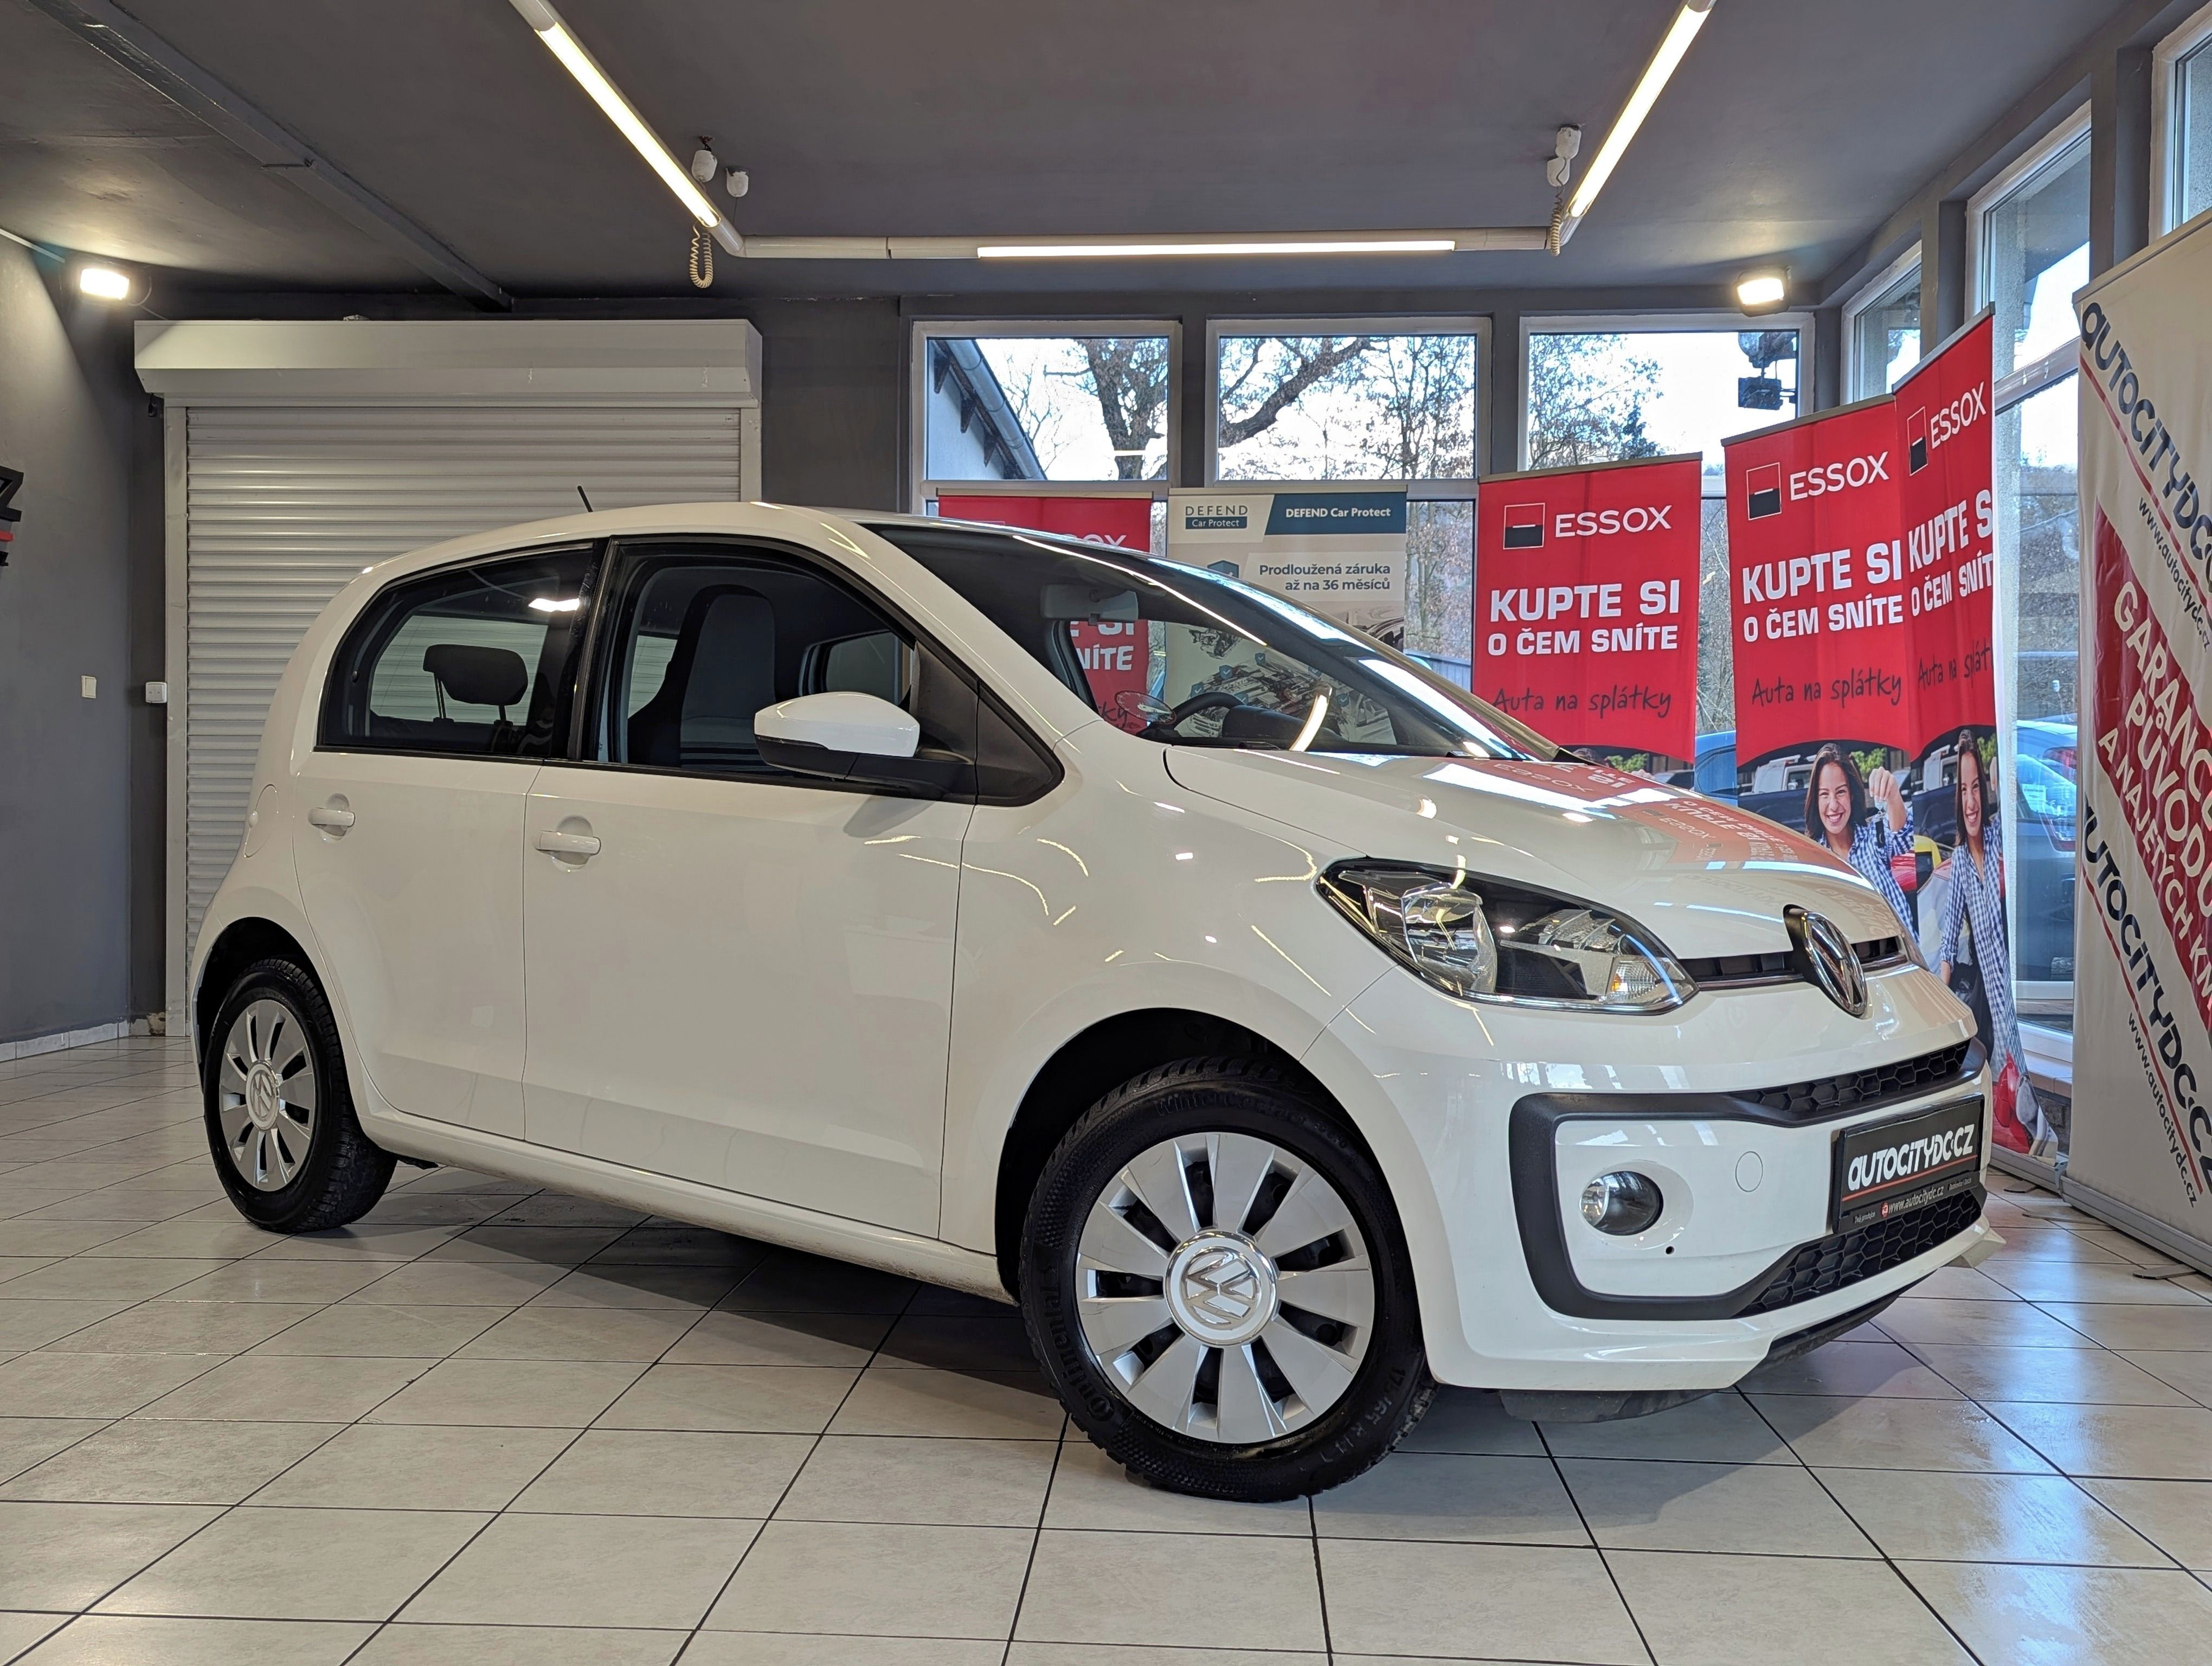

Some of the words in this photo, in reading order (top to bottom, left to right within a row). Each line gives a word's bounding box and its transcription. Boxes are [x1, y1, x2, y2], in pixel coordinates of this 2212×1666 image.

[1930, 381, 1986, 449] ESSOX
[1790, 451, 1889, 501] ESSOX
[1186, 505, 1248, 516] DEFEND
[1192, 519, 1206, 527] Car
[1208, 518, 1240, 527] Protect
[1285, 508, 1328, 518] DEFEND
[1330, 508, 1348, 517] Car
[1351, 508, 1391, 517] Protect
[1555, 505, 1672, 537] ESSOX
[1908, 499, 1969, 573] KUPTE
[1976, 489, 1993, 538] S
[1259, 563, 1342, 575] Prodloužená
[1345, 563, 1391, 575] záruka
[1285, 579, 1301, 591] až
[1303, 582, 1320, 591] na
[1322, 579, 1339, 591] 36
[1342, 577, 1391, 591] měsíců
[1742, 549, 1853, 605] KUPTE
[1866, 540, 1902, 584] SI
[1911, 586, 1920, 617] O
[1924, 571, 1953, 611] ČEM
[1959, 549, 1993, 597] SNÍT
[2139, 497, 2210, 653] www.autocitydc.cz
[1490, 584, 1623, 623] KUPTE
[1639, 579, 1681, 615] SI
[1744, 616, 1759, 642] O
[1766, 603, 1819, 639] ČEM
[1828, 593, 1903, 632] SNÍTE
[1075, 644, 1134, 670] NÍTE
[1488, 633, 1506, 656] O
[1517, 627, 1580, 655] ČEM
[1591, 622, 1678, 652] SNÍTE
[1918, 653, 1944, 691] Auta
[1964, 637, 1991, 688] splát
[1493, 687, 1544, 713] Auta
[1555, 694, 1577, 710] na
[1588, 684, 1671, 720] splátky
[1752, 676, 1794, 706] Auta
[1804, 682, 1821, 700] na
[1831, 668, 1901, 708] splátky
[2098, 727, 2118, 764] A
[2116, 754, 2194, 940] NAJETÝCH
[2129, 1012, 2197, 1208] www.autocitydc.cz
[1889, 1186, 1944, 1214] www.autocitydc.cz
